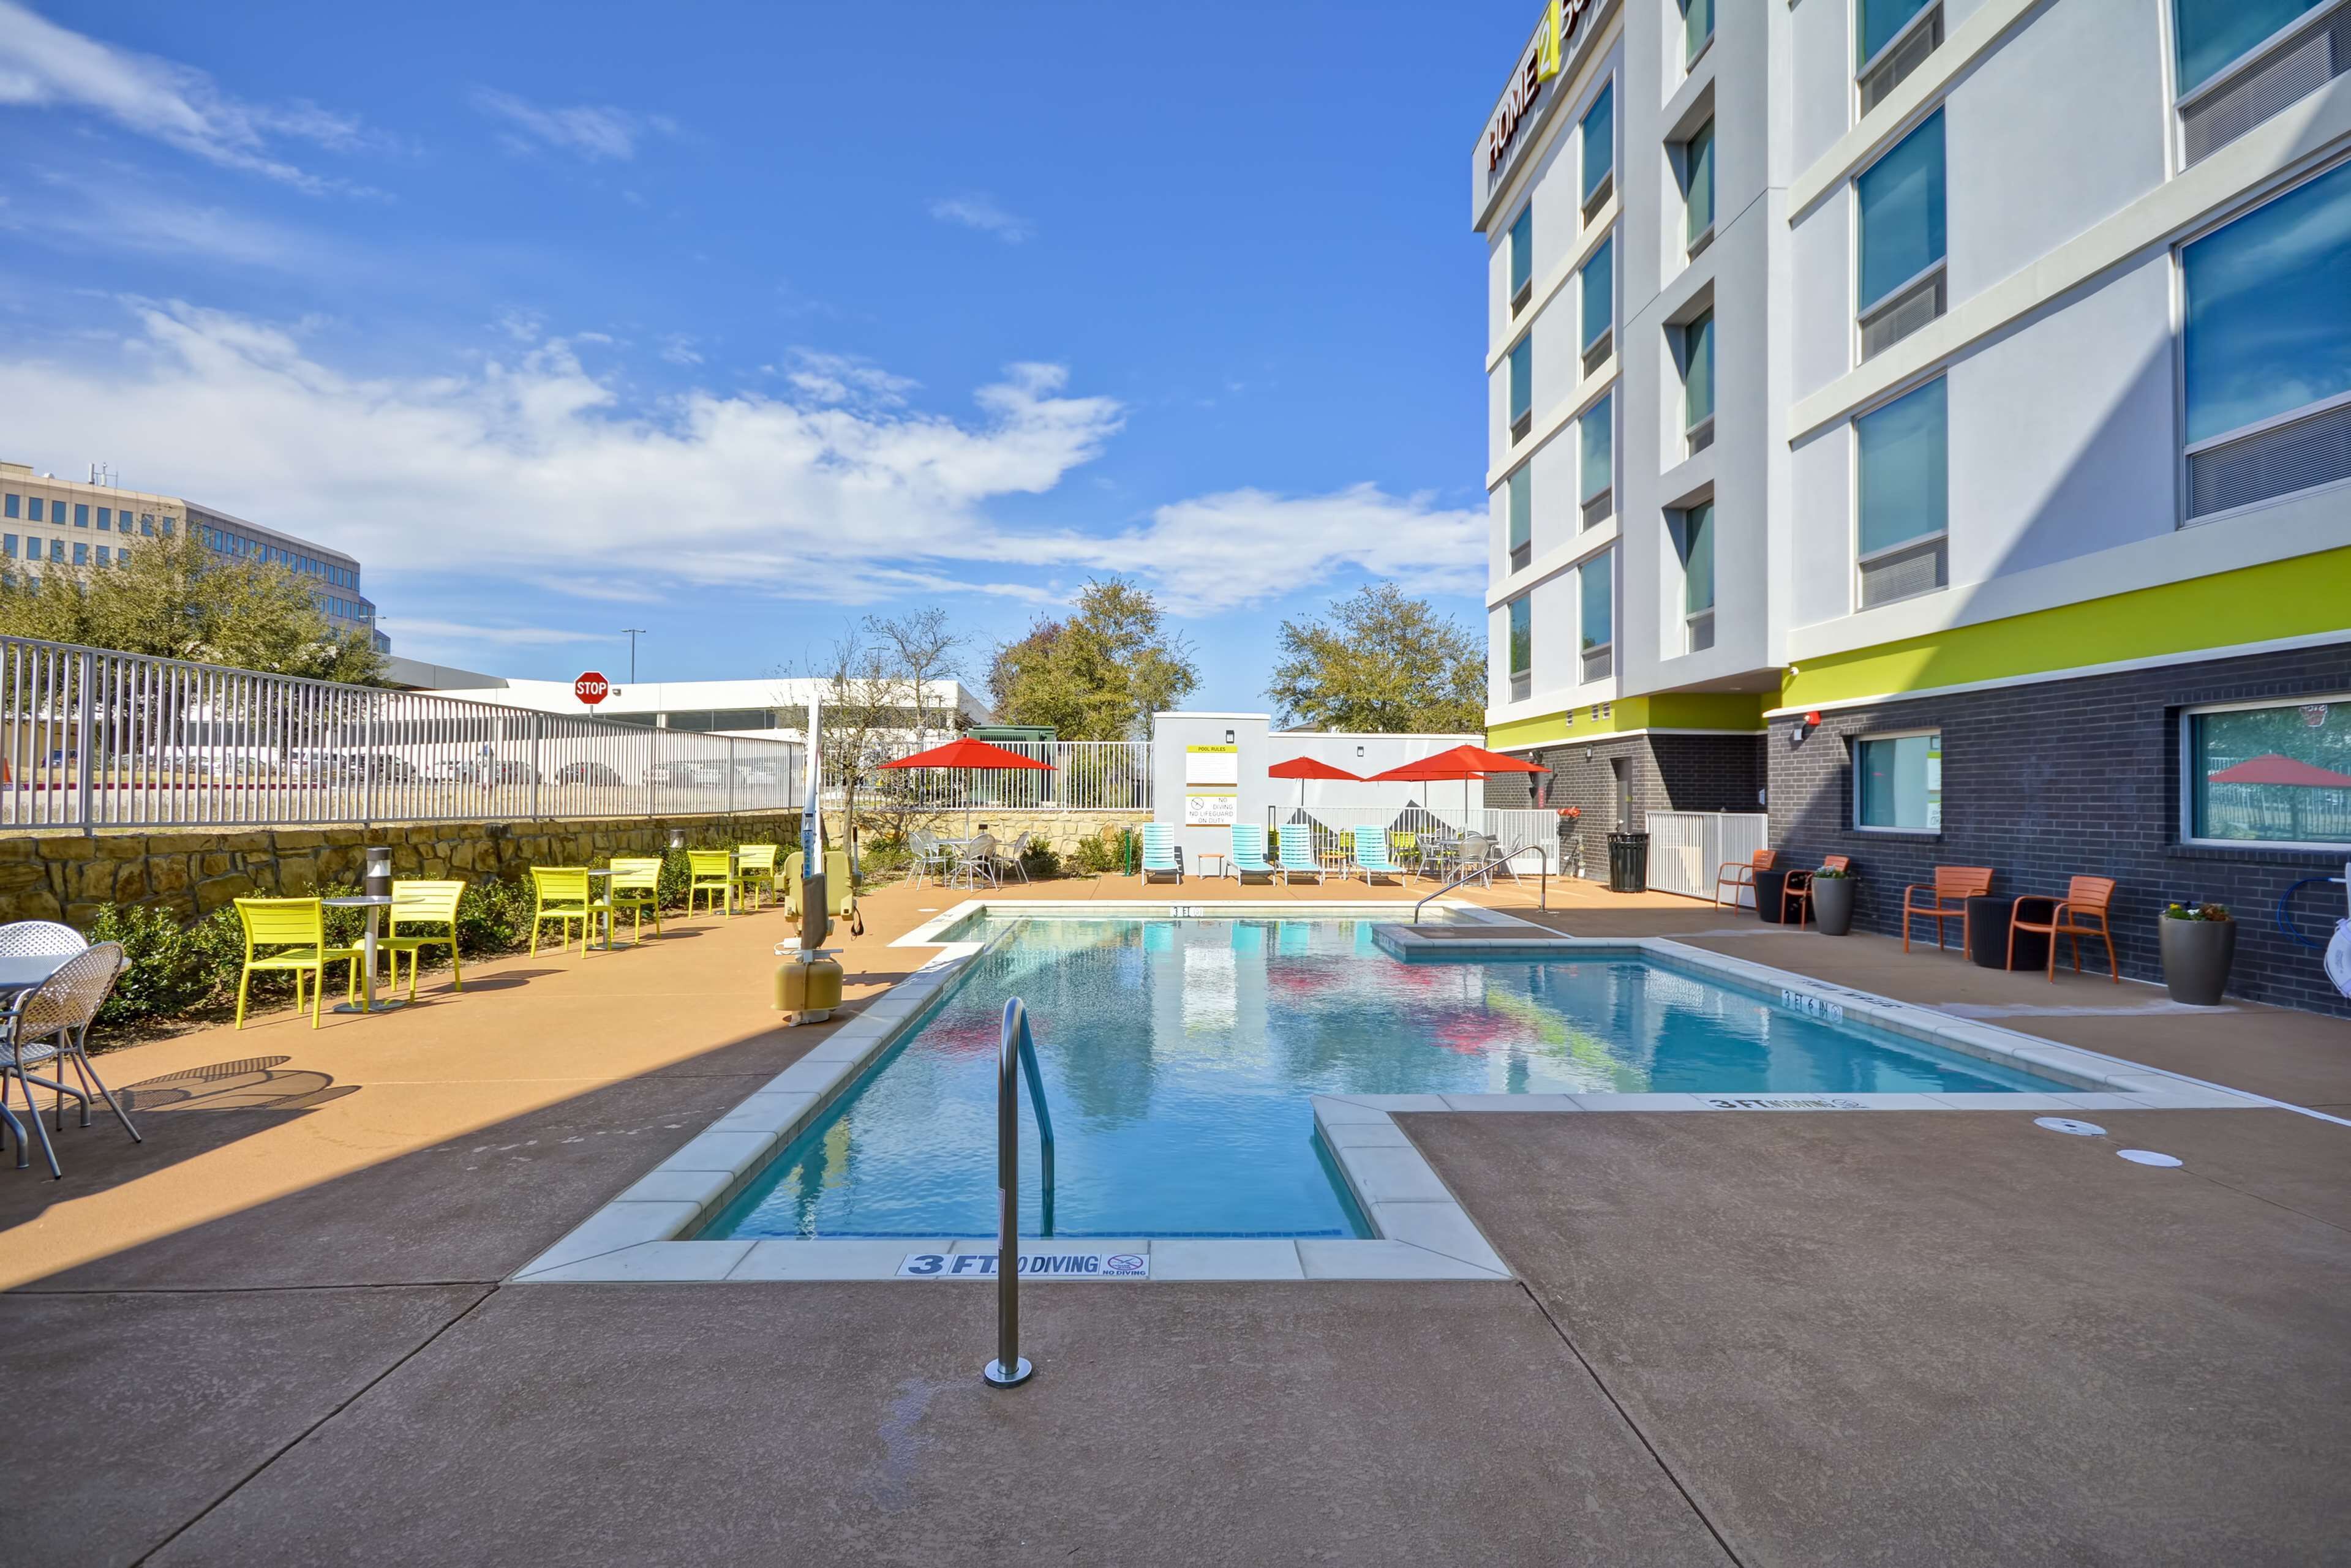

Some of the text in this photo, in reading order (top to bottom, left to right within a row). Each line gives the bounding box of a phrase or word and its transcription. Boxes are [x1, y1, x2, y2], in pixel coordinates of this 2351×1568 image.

[576, 682, 607, 695] STOP
[1808, 999, 1813, 1010] 6
[1819, 1000, 1828, 1012] IN
[1709, 1100, 1737, 1108] 3
[908, 1255, 944, 1274] 3
[1030, 1256, 1098, 1272] DIVING
